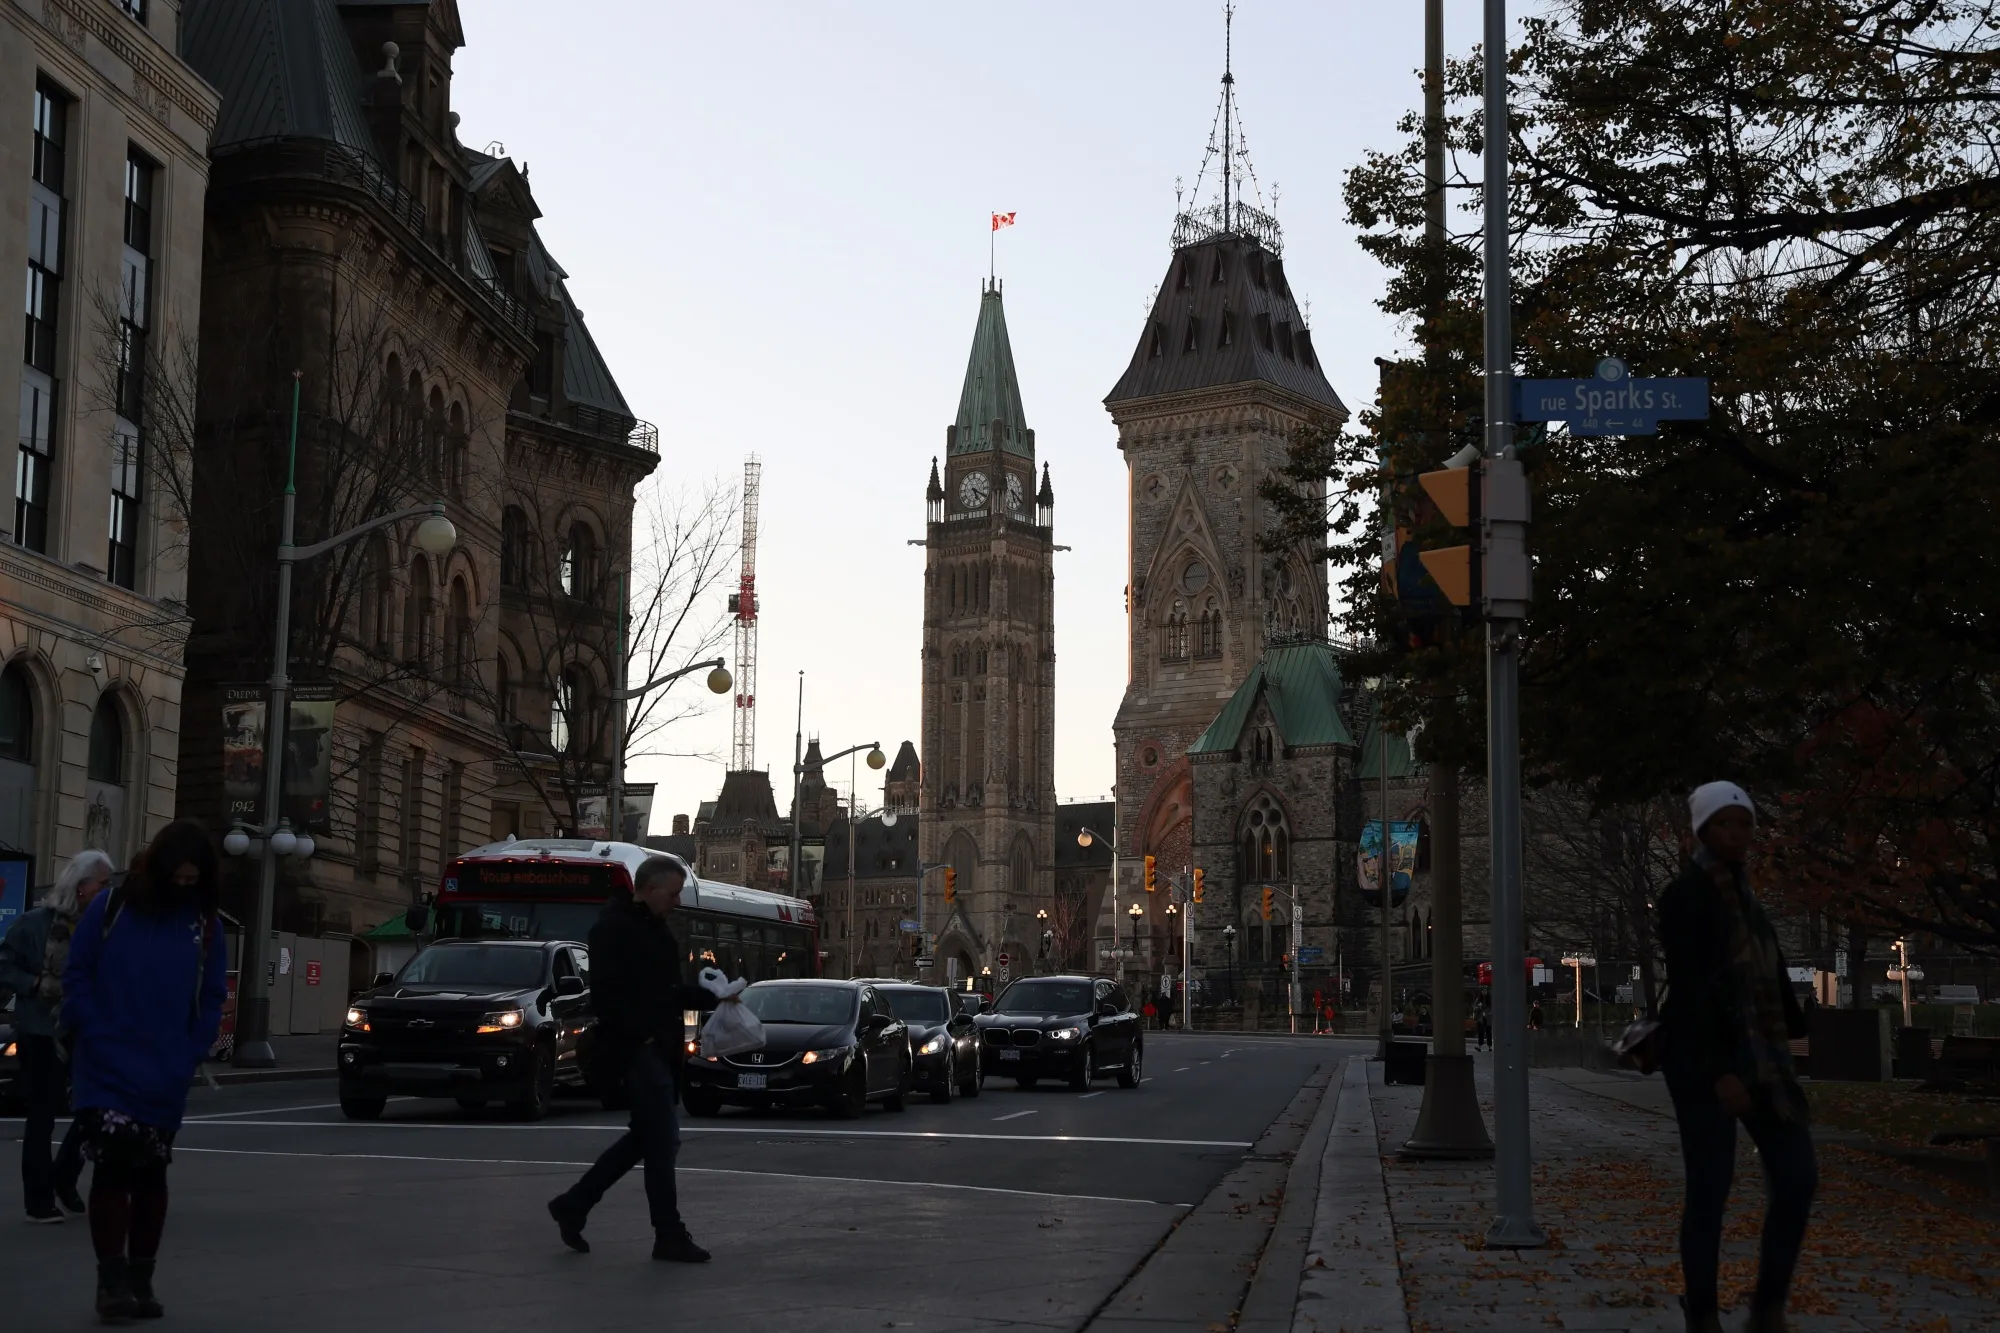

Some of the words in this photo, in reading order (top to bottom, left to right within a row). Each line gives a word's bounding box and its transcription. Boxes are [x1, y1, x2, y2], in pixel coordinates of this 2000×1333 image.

[1541, 397, 1566, 411] rue
[1575, 382, 1654, 417] Sparks
[1662, 392, 1682, 409] St.
[1632, 419, 1643, 429] 44
[228, 689, 260, 699] DIEPPE
[230, 800, 255, 813] 1942
